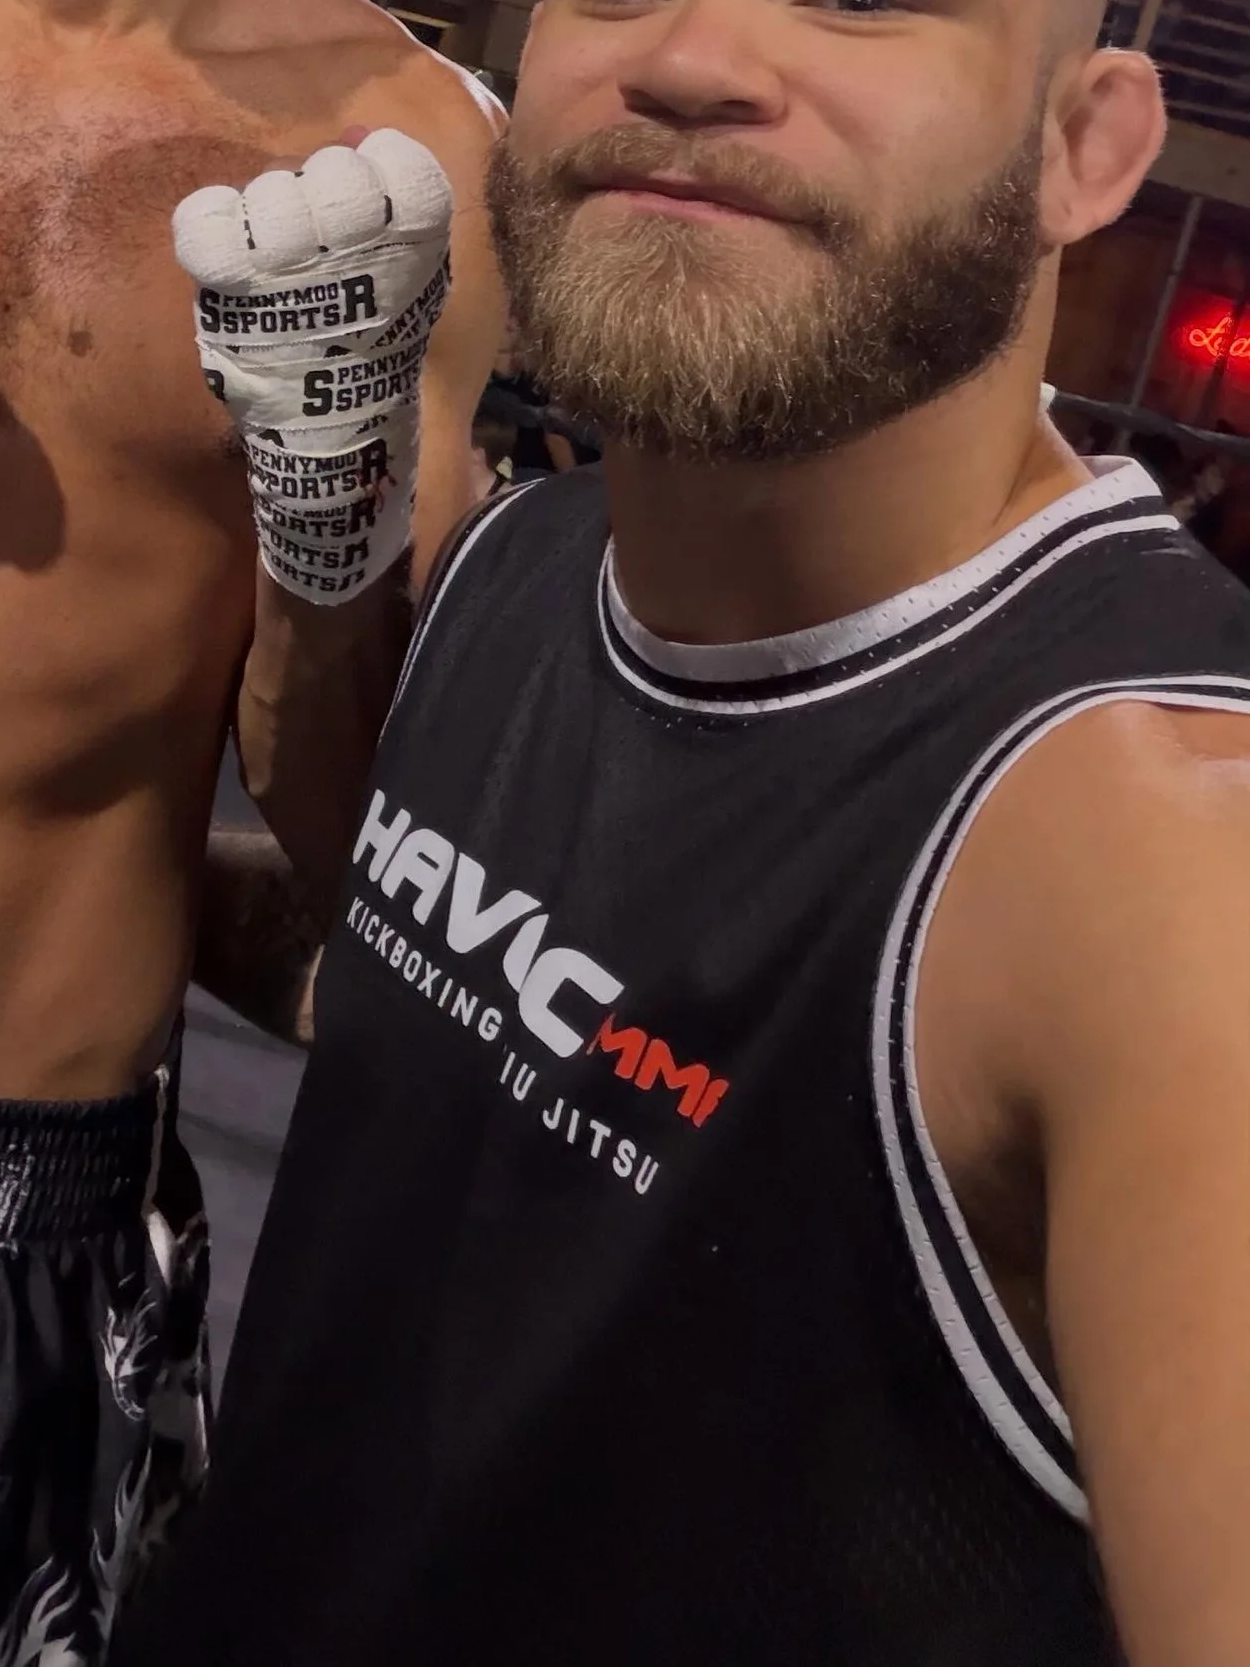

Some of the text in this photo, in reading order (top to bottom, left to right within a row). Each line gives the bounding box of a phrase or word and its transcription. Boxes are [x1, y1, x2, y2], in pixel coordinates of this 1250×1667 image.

[224, 301, 341, 334] SPORTS
[347, 896, 660, 1195] KICKBOXING IU JITSU
